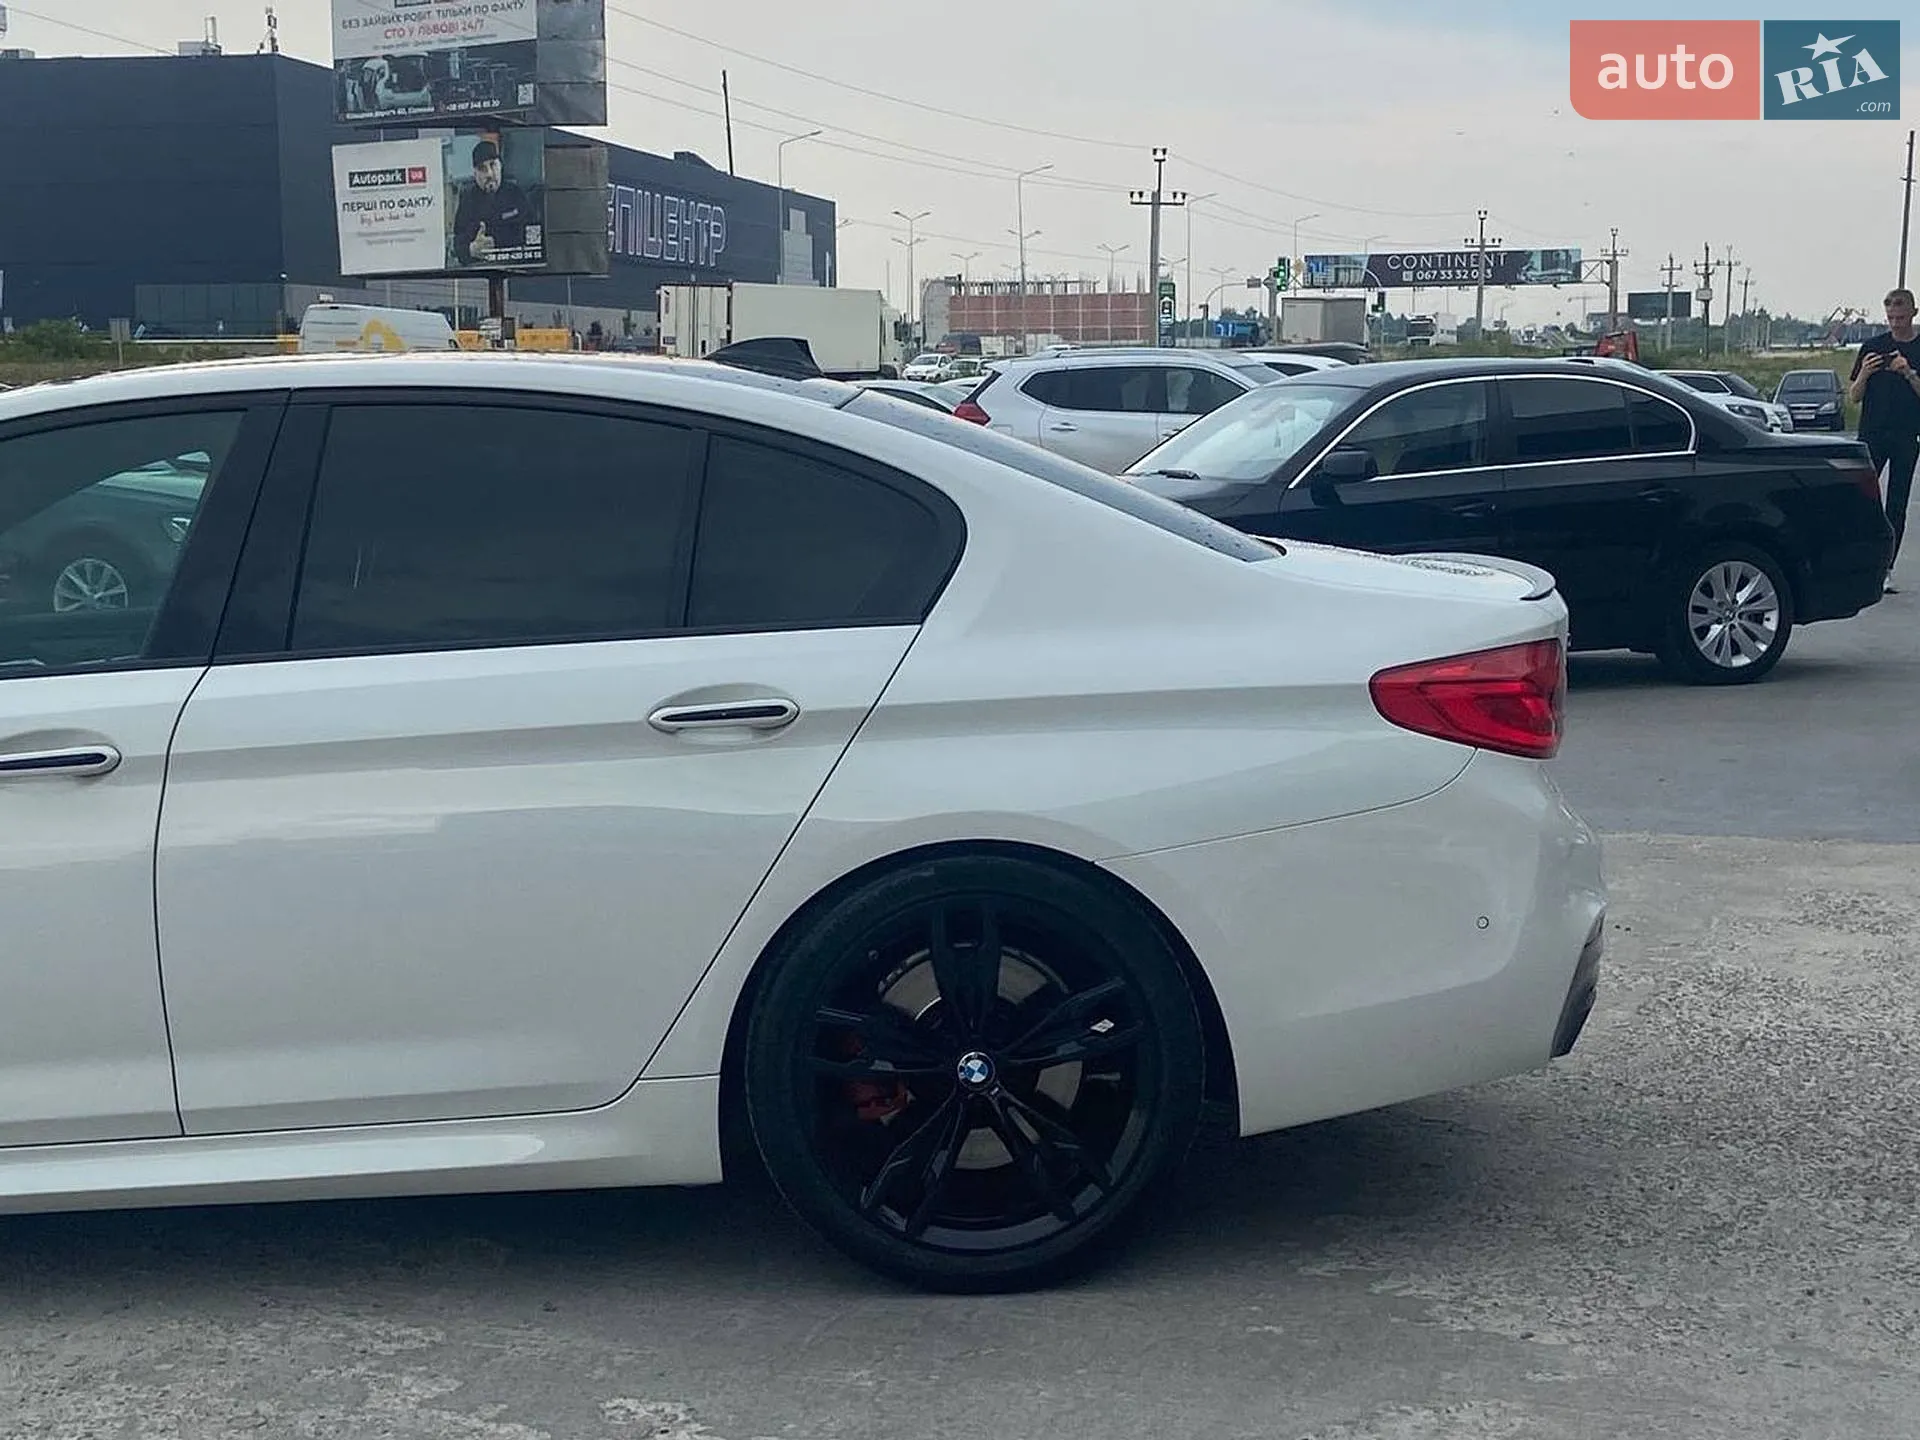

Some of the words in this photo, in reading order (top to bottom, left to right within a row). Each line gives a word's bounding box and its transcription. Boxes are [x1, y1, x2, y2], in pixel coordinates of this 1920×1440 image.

[384, 27, 406, 39] СТО
[408, 26, 415, 37] У
[418, 22, 459, 36] ЛЬВОВІ
[460, 17, 485, 32] 24/7
[352, 172, 402, 186] Autopark
[342, 201, 378, 213] ПЕРШІ
[379, 199, 396, 210] ПО
[1387, 253, 1508, 270] CONTINENT
[1416, 269, 1437, 280] 067
[1439, 269, 1454, 280] 33
[1456, 269, 1470, 279] 32
[1471, 268, 1493, 279] 03
